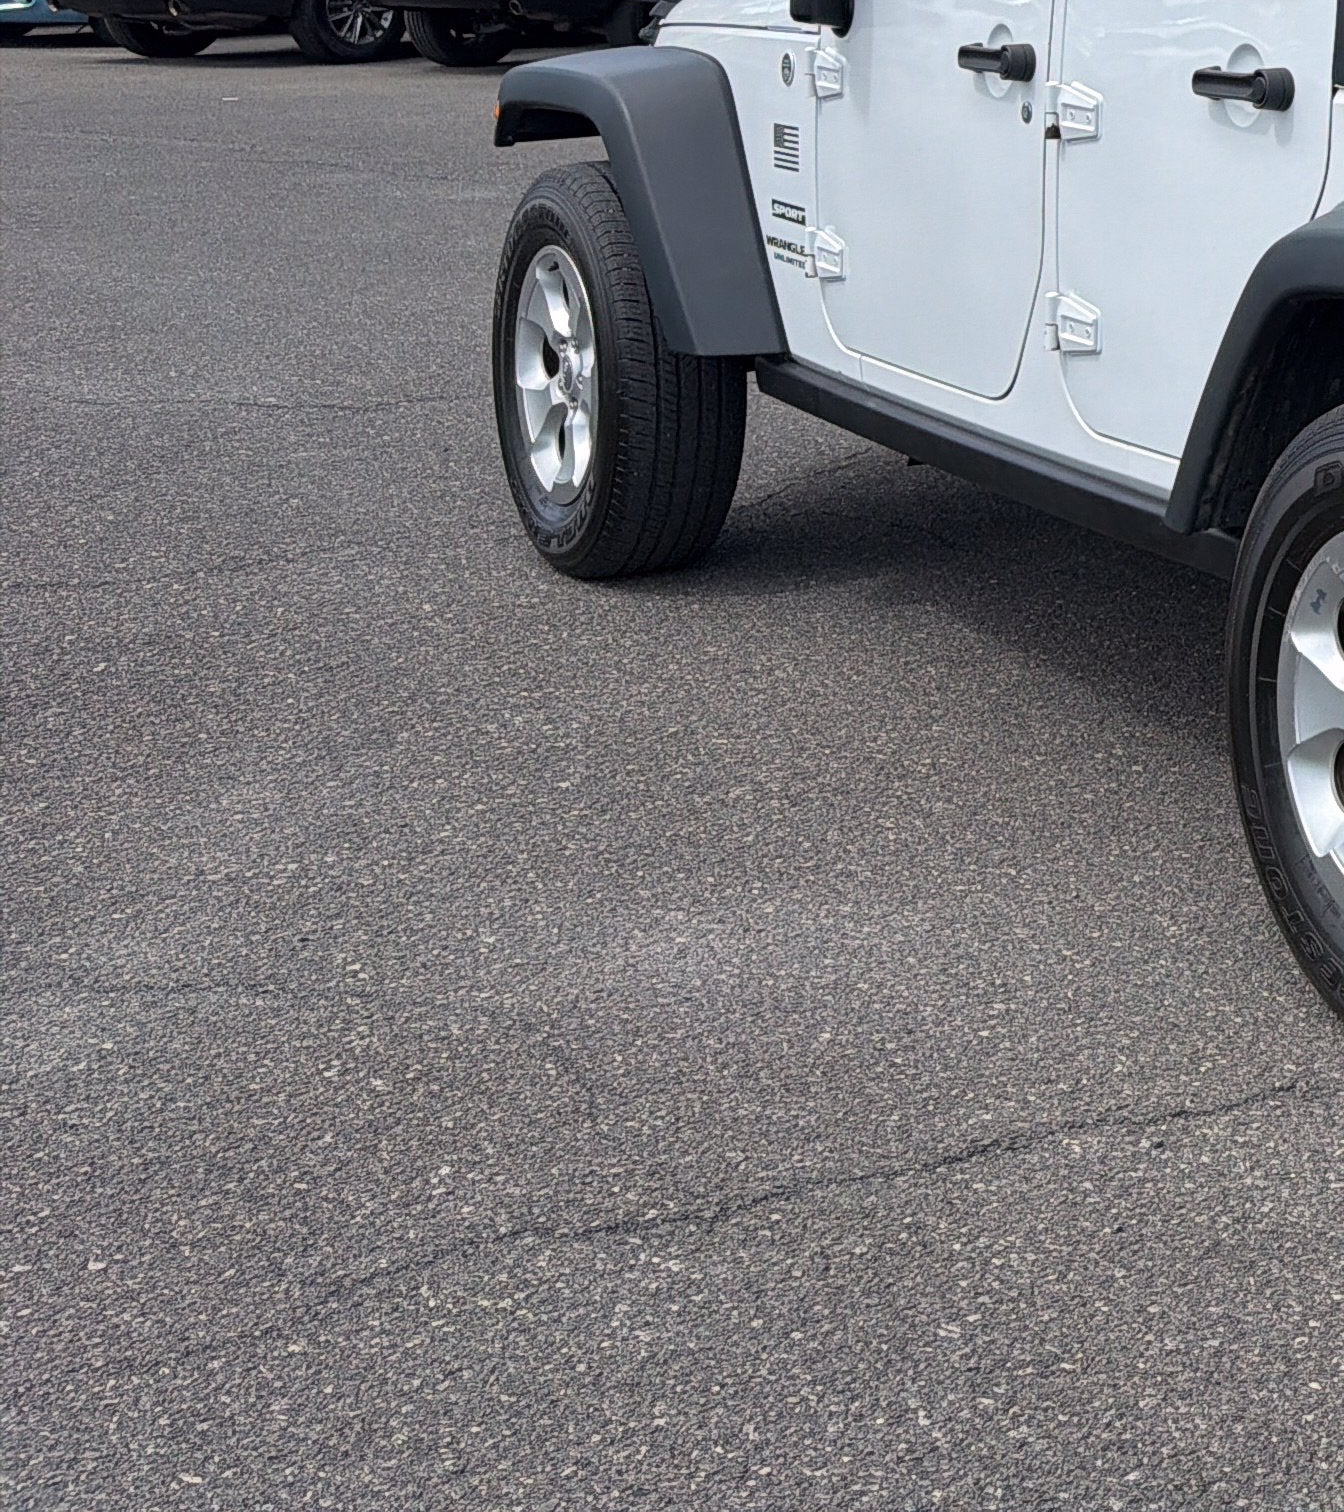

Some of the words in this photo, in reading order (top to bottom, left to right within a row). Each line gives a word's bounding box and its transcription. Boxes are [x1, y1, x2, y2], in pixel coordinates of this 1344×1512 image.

[773, 201, 804, 223] SPORT
[766, 234, 807, 257] WRANGLE
[774, 251, 806, 270] UNLIMITE
